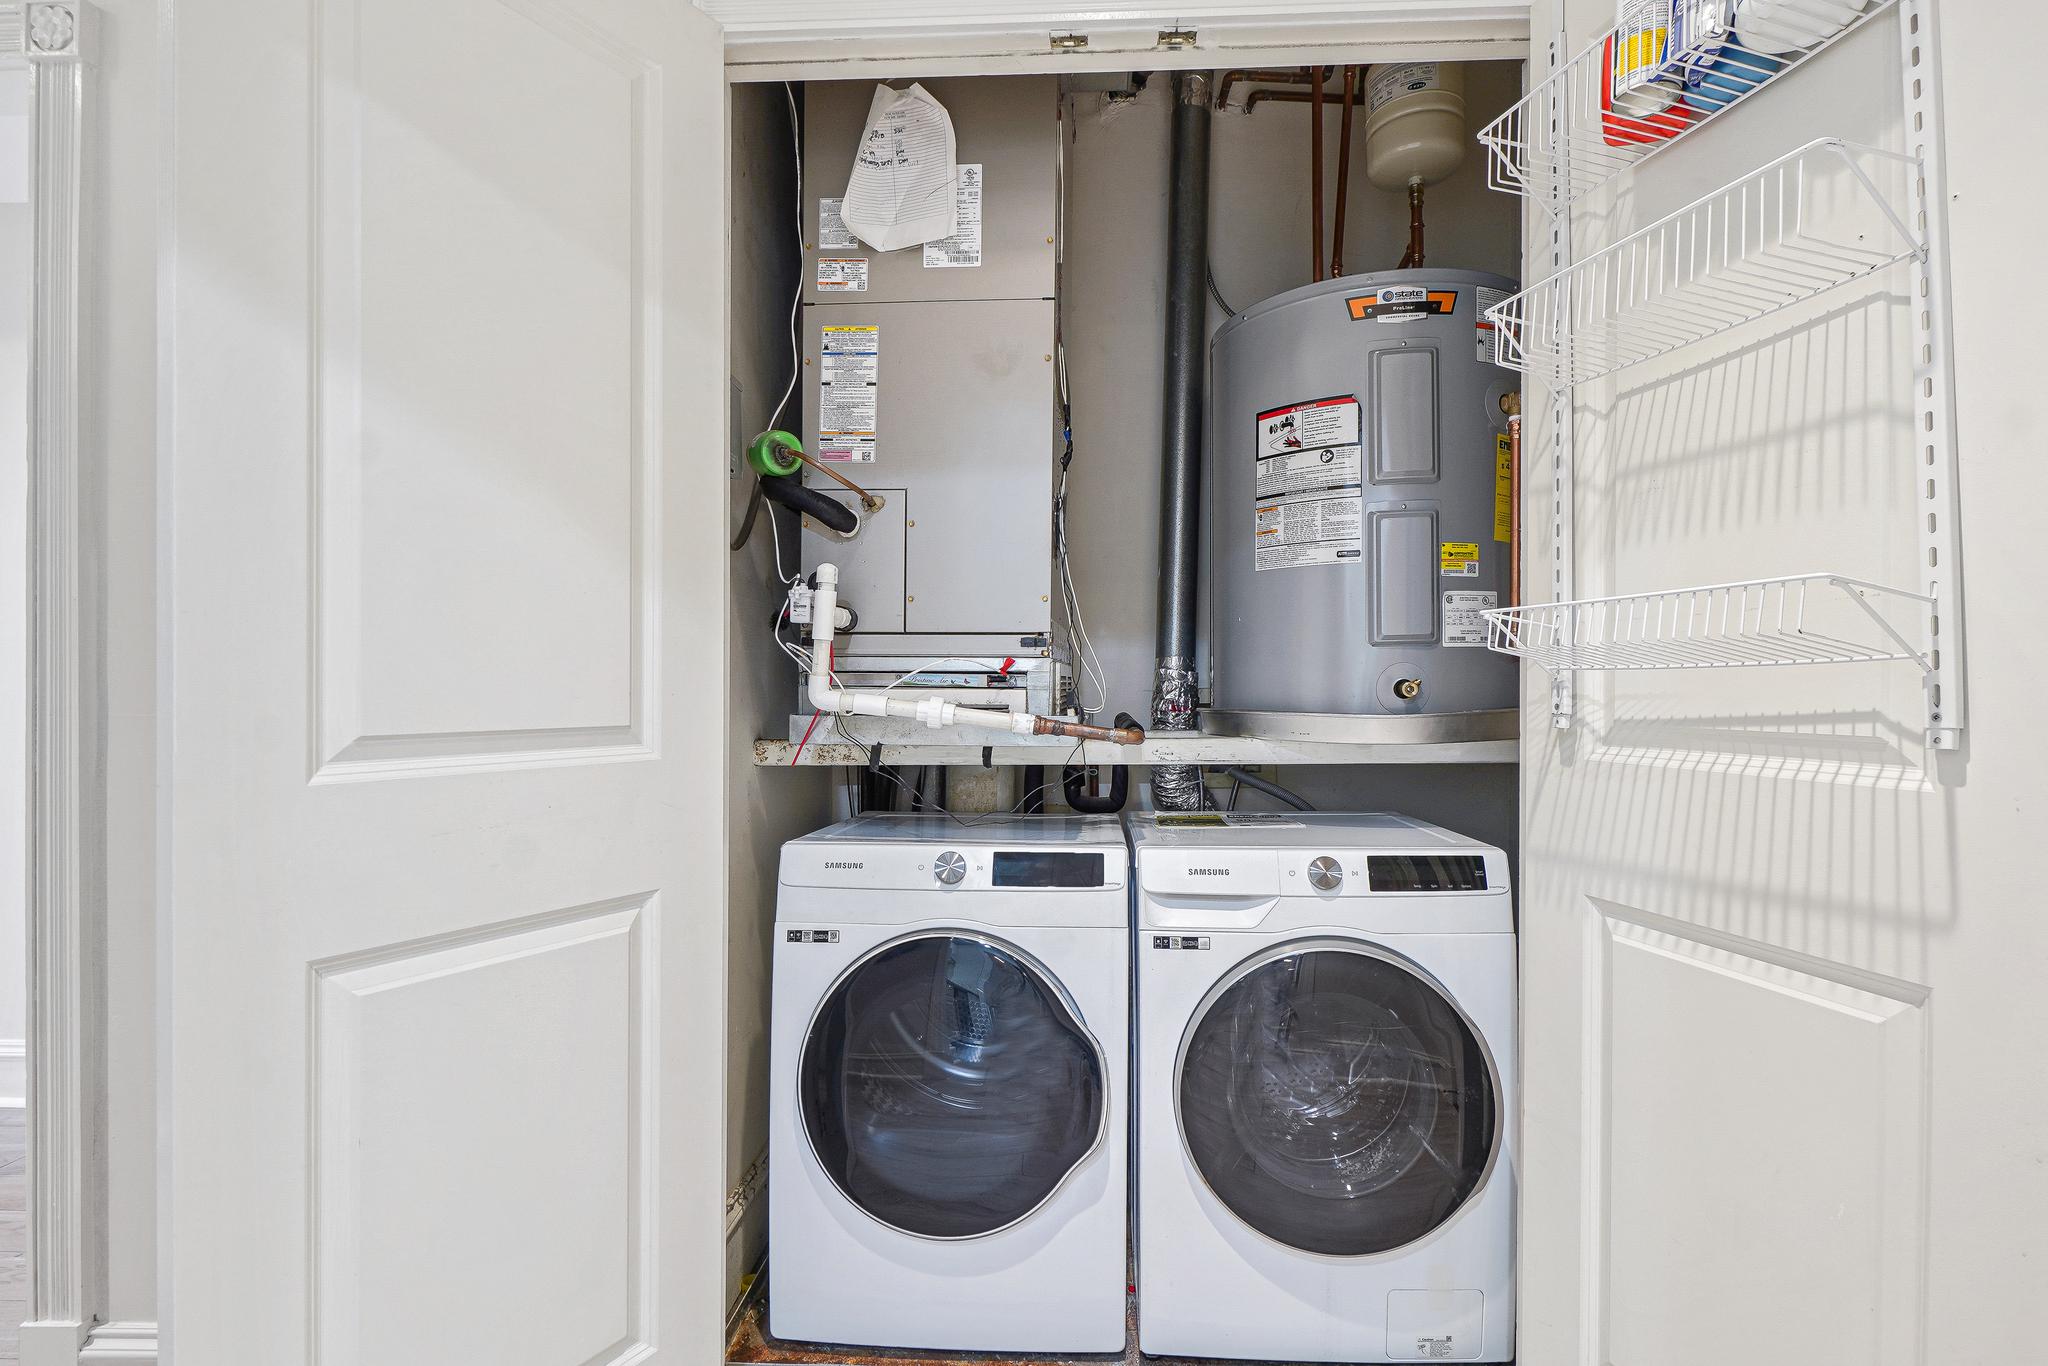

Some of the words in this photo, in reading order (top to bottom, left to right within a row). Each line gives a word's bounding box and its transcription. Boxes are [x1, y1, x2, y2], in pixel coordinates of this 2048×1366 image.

[1395, 290, 1424, 298] state
[1296, 403, 1317, 412] DANGER
[824, 861, 864, 870] SAMSUNG
[1188, 868, 1230, 876] SAMSUNG
